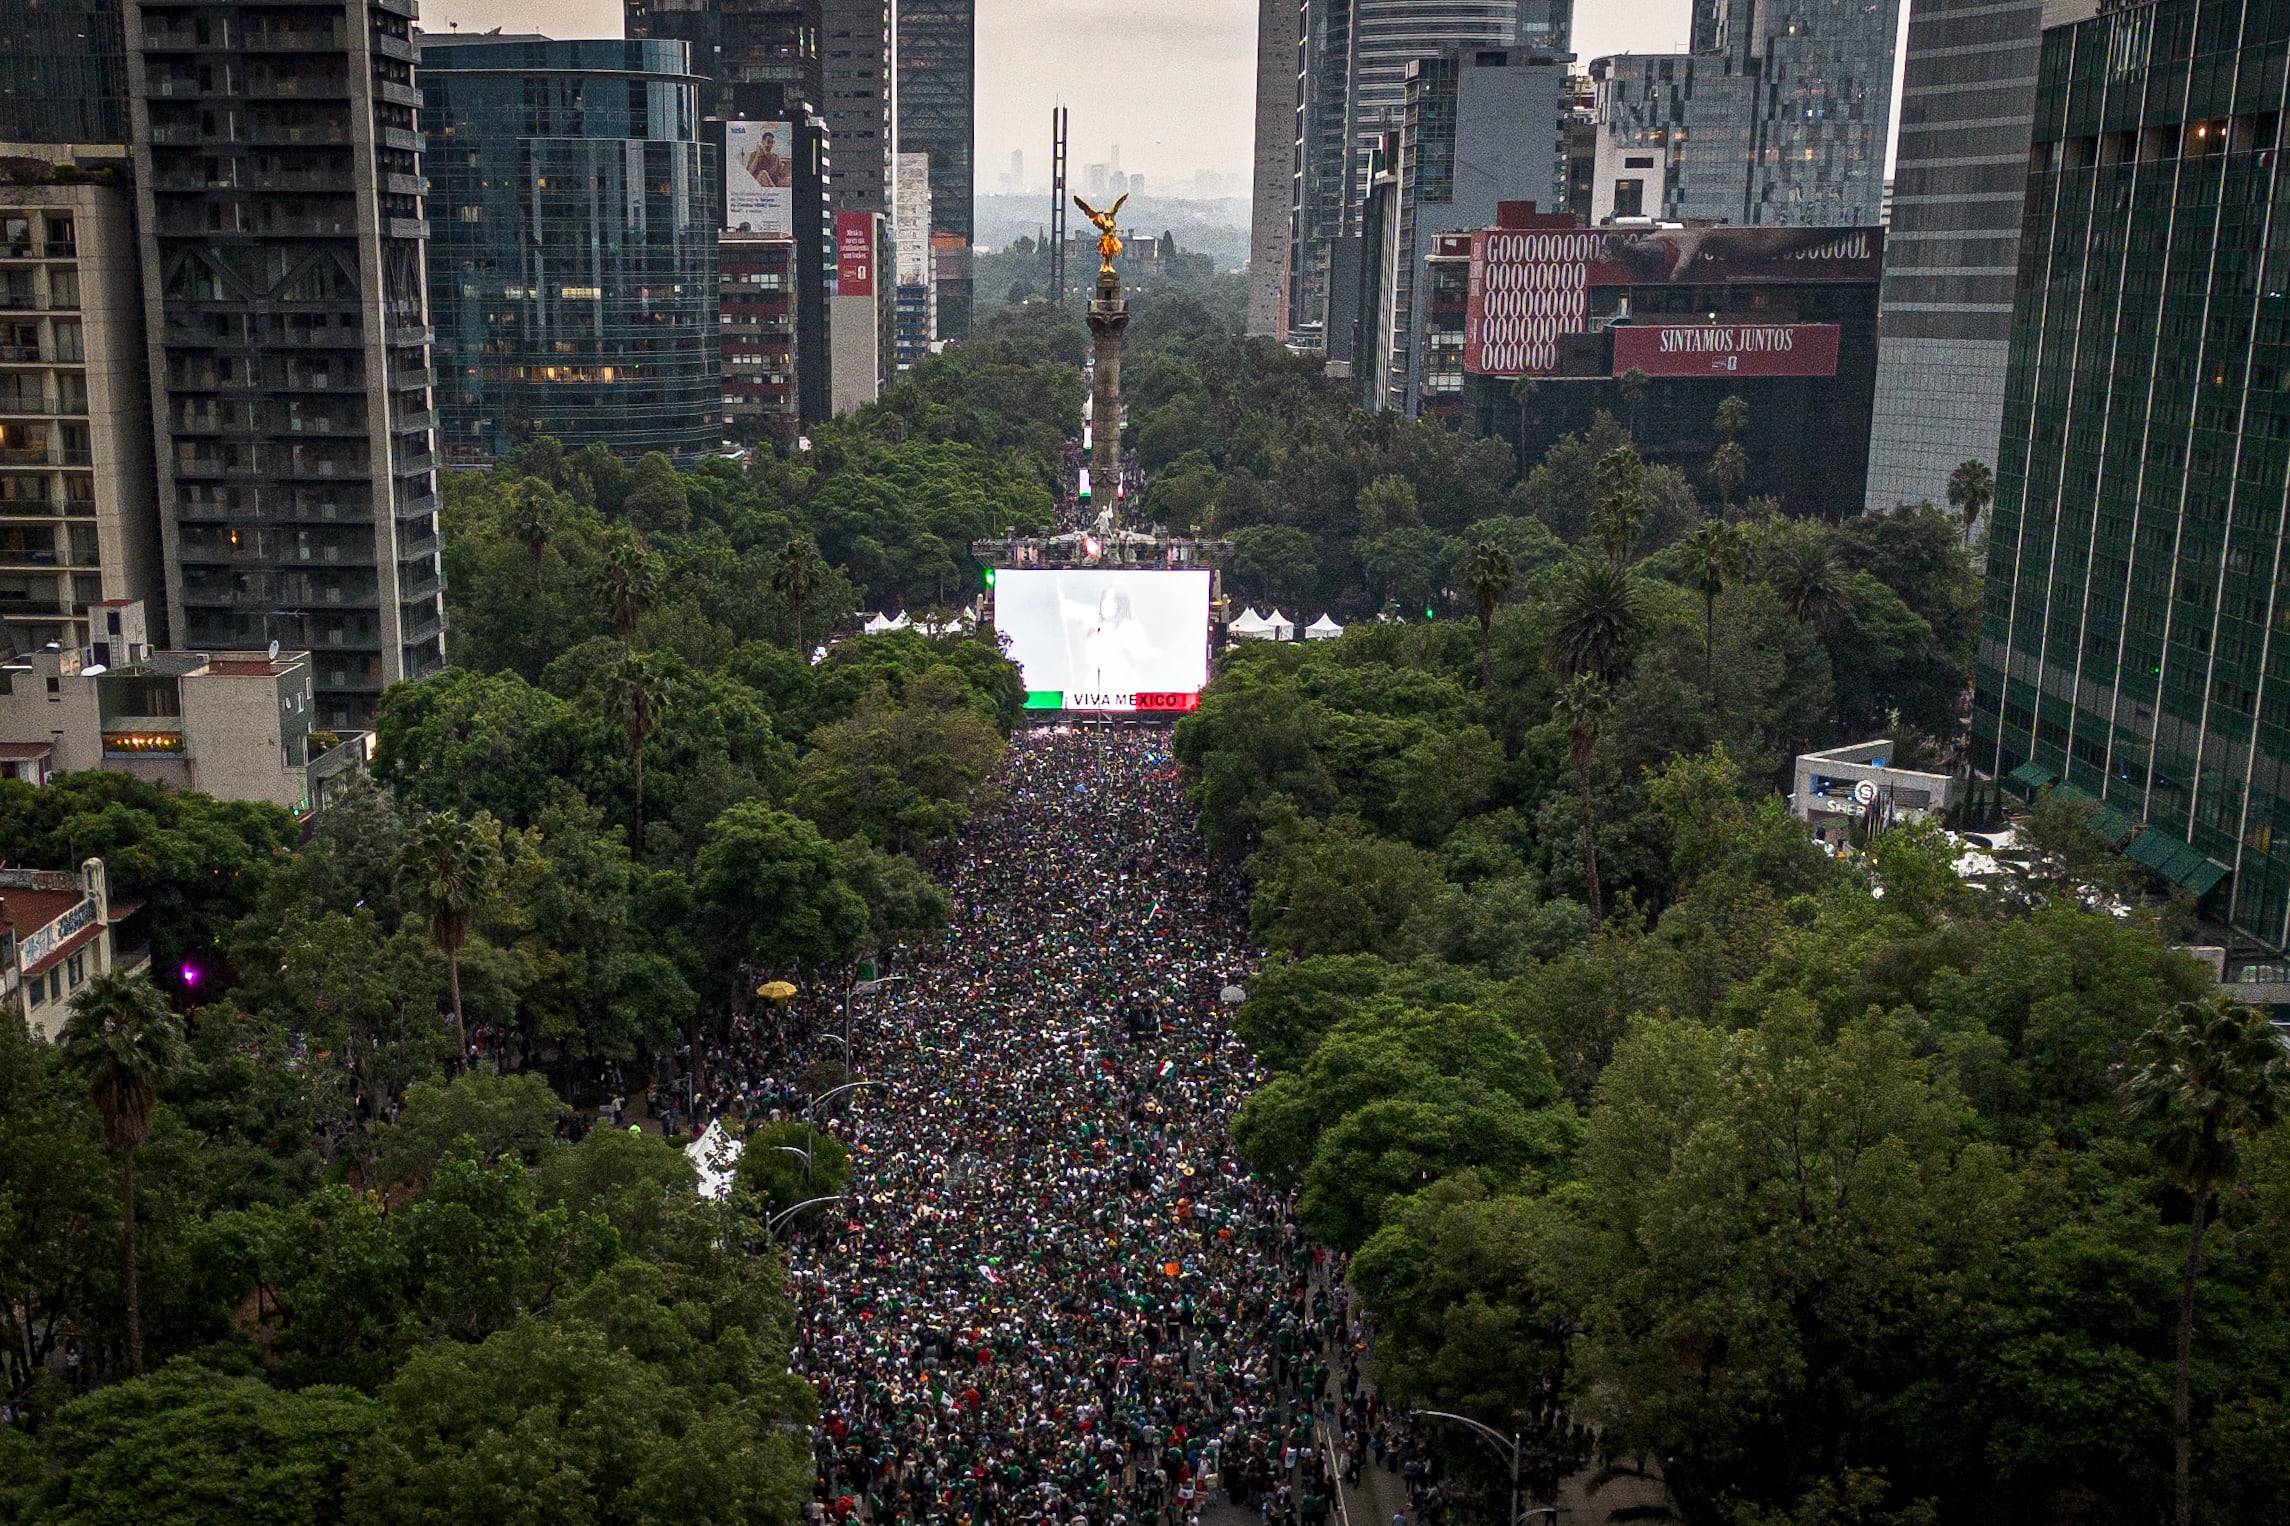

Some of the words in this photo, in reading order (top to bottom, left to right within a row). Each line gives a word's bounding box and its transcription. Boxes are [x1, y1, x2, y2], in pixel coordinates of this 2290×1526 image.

[1660, 329, 1733, 352] SINTAMOS
[1736, 328, 1793, 351] JUNTOS
[1074, 694, 1110, 706] VIVA
[1115, 694, 1177, 707] MEXICO
[1826, 800, 1867, 817] SHER
